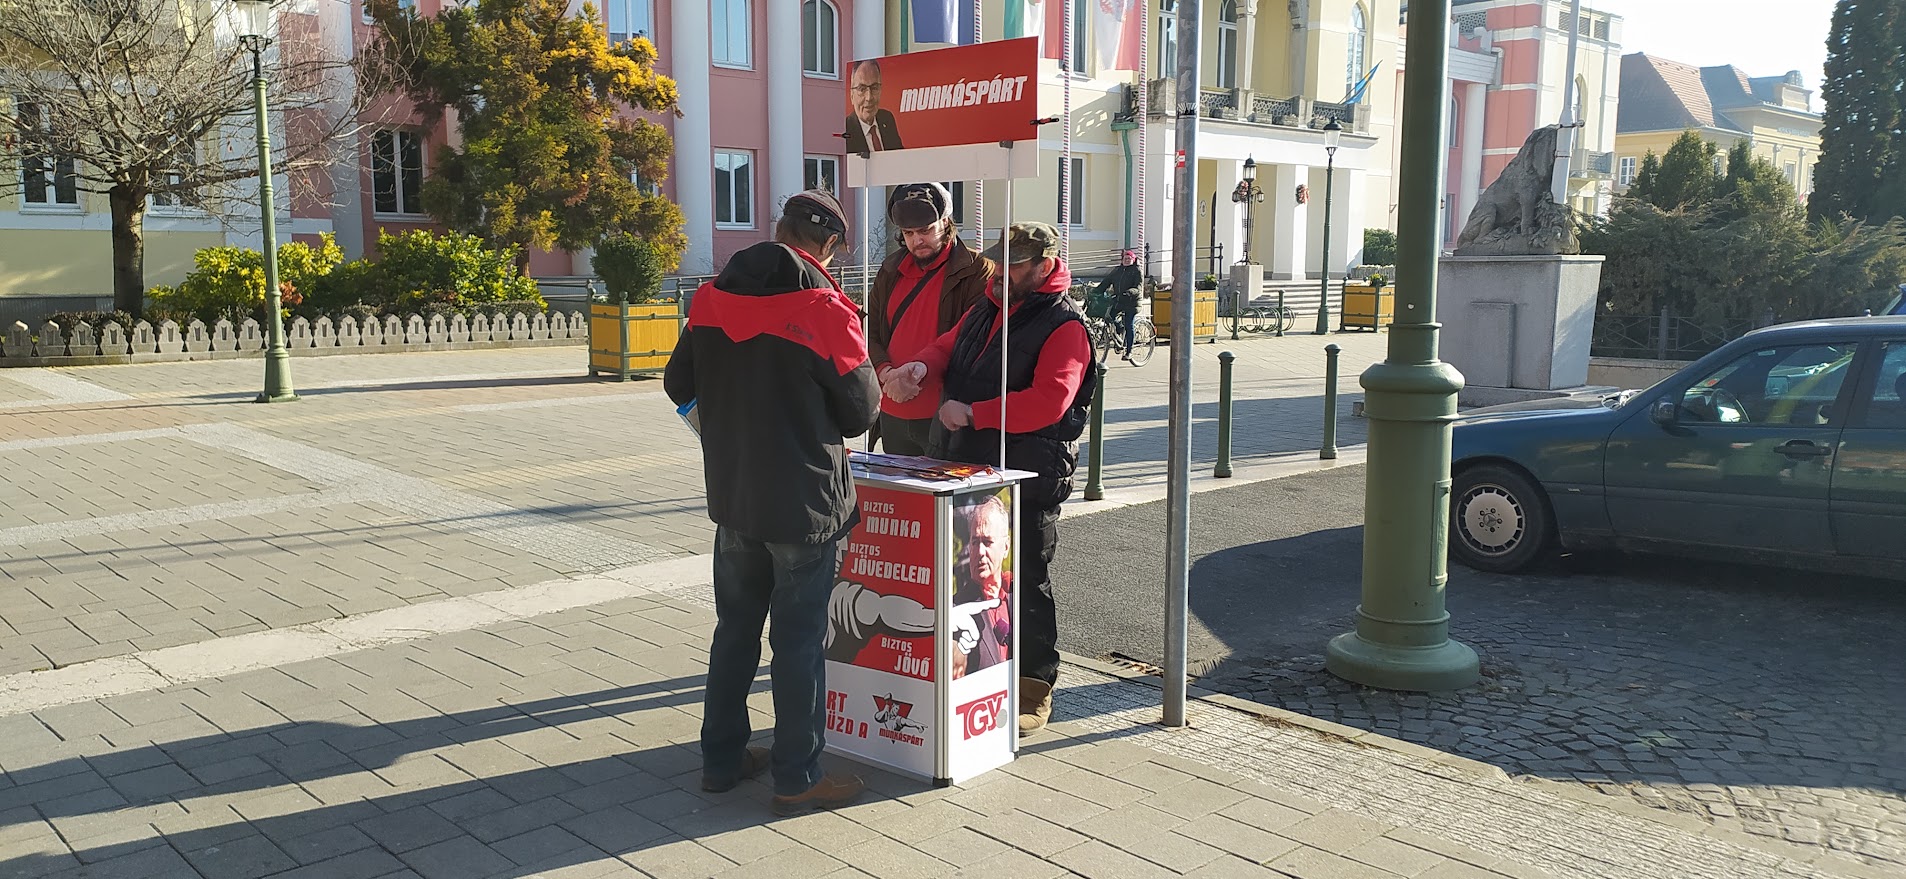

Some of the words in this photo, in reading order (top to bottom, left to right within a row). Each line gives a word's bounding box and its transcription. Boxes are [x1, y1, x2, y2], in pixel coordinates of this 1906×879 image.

[900, 73, 1028, 112] MUNKÁSPÁRT
[863, 501, 894, 514] BIZTOS
[866, 516, 921, 538] MUNKA
[850, 543, 881, 556] BIZTOS
[851, 554, 931, 585] JÖVEDELEM
[881, 637, 913, 653] BIZTOS
[894, 653, 930, 678] JÖVŐ
[858, 721, 869, 738] A
[879, 727, 925, 747] MUNKÁSPÁRT
